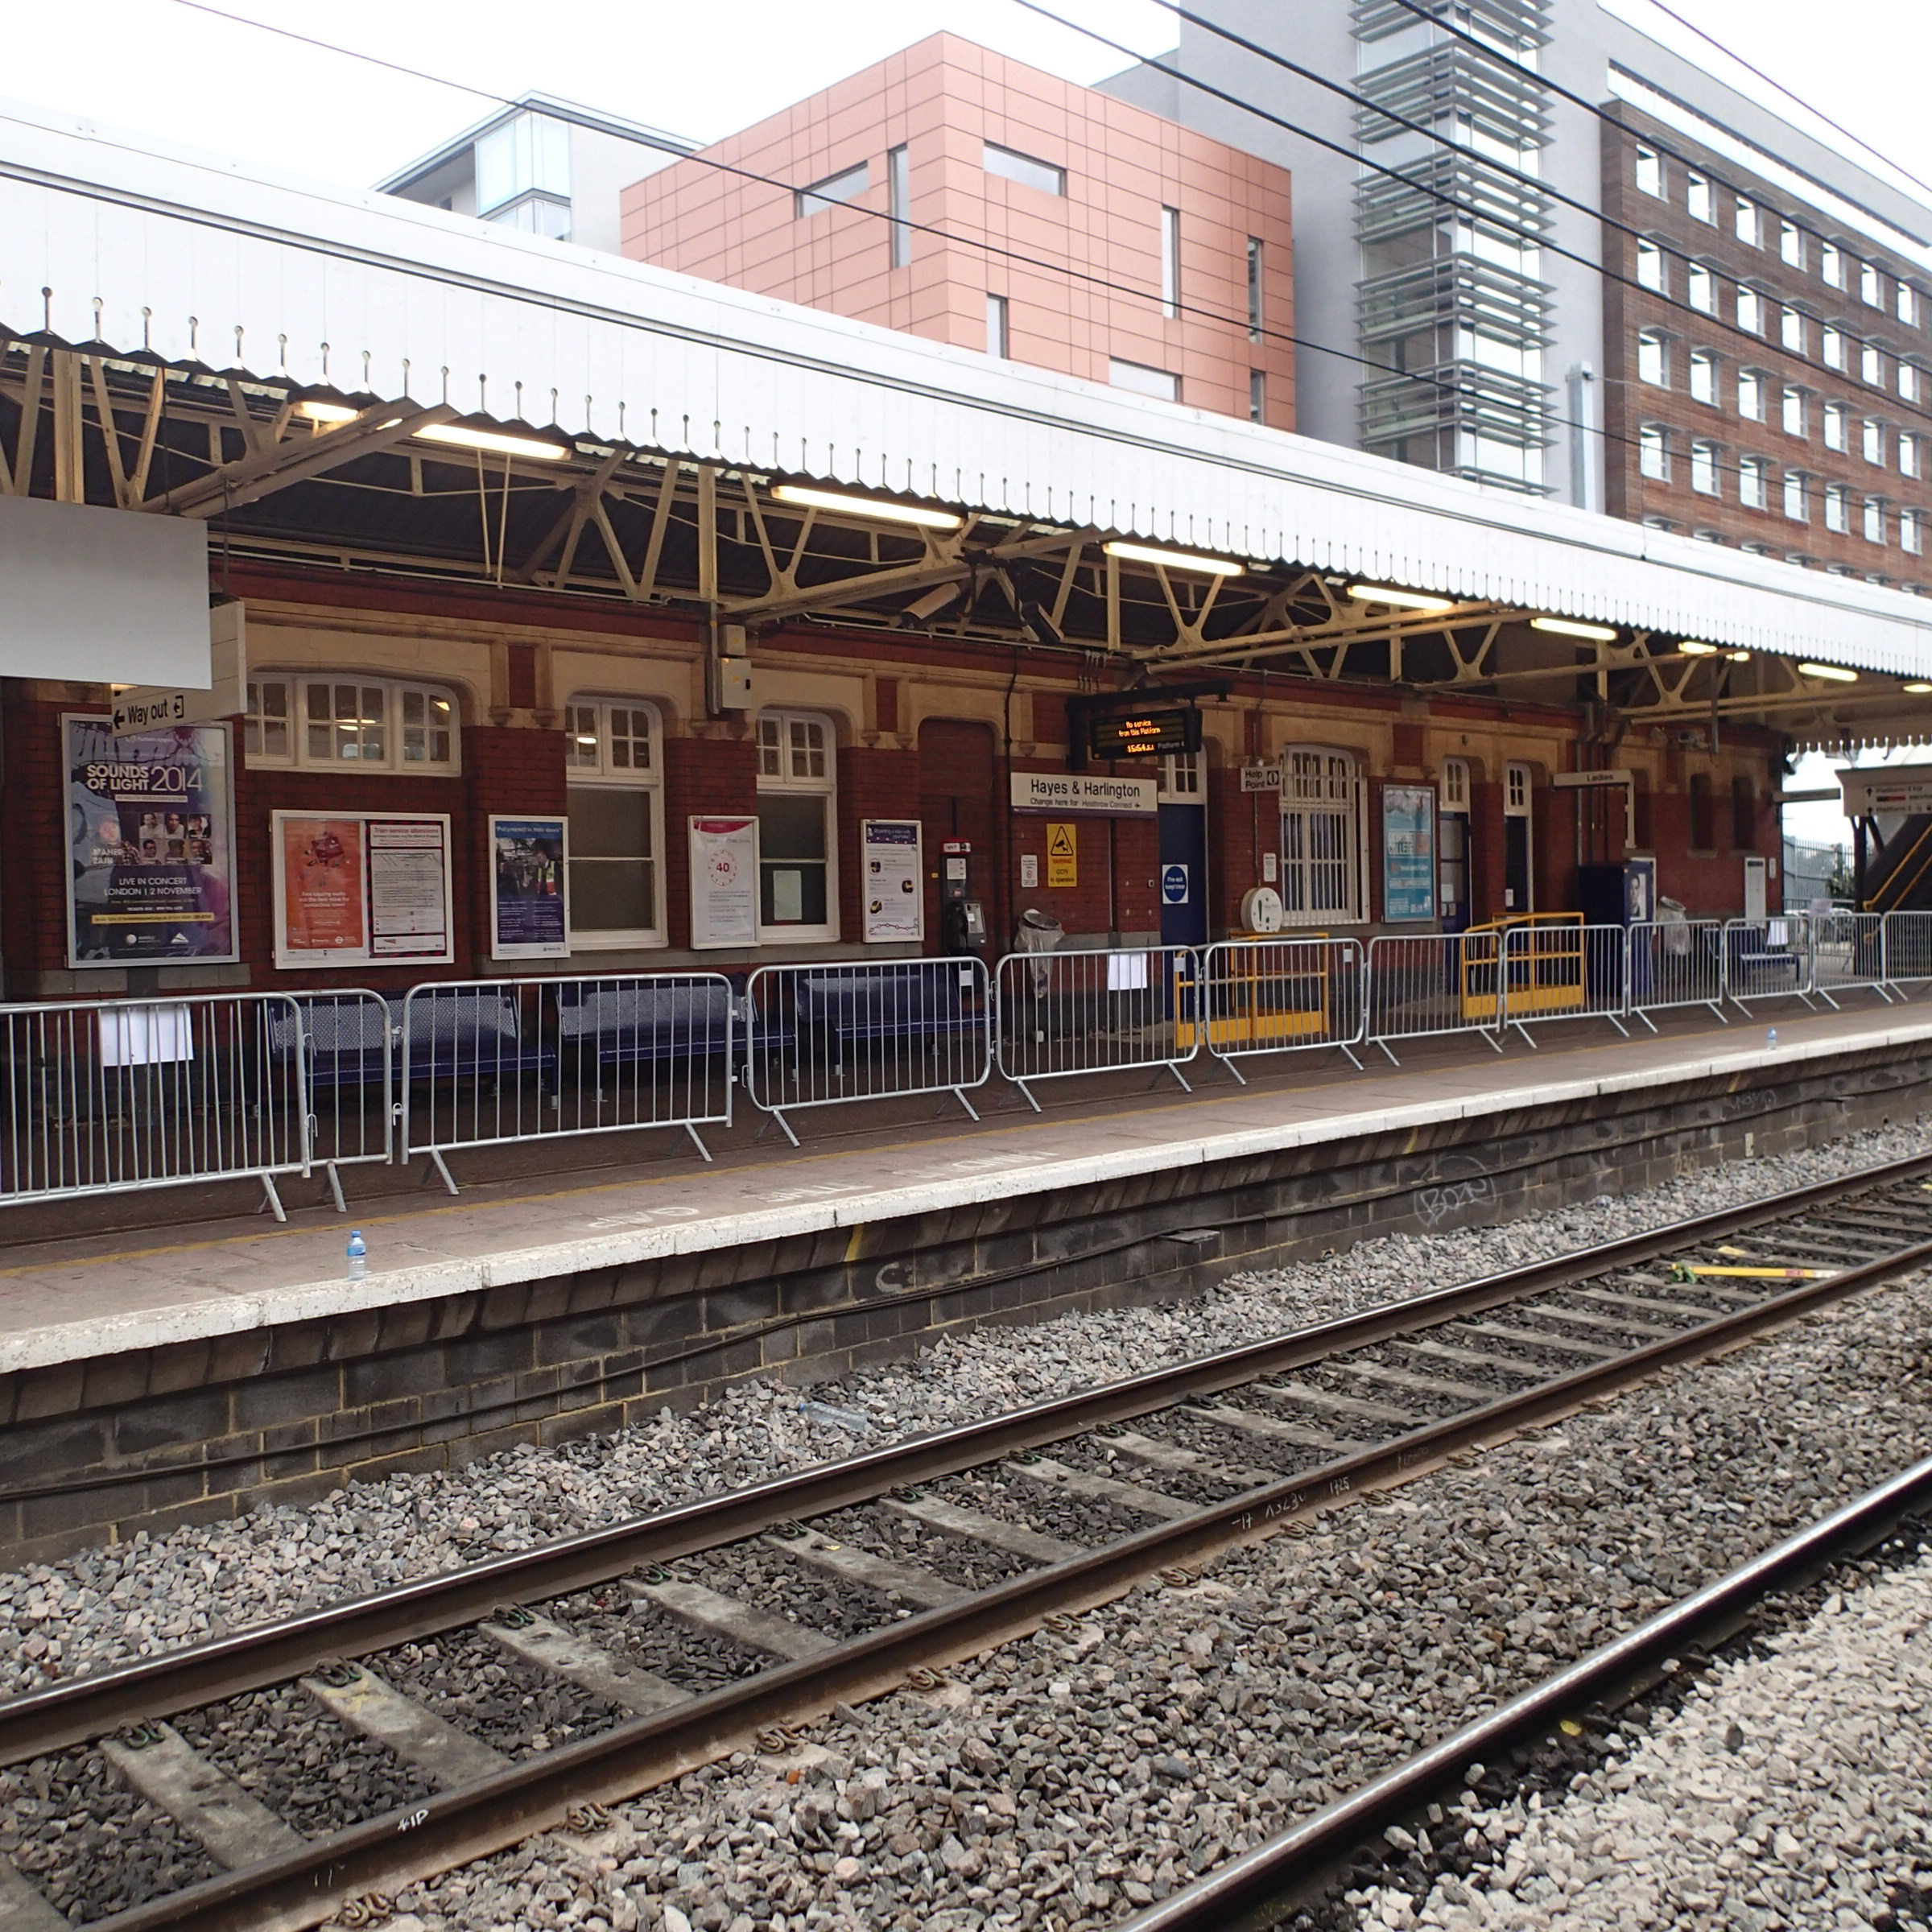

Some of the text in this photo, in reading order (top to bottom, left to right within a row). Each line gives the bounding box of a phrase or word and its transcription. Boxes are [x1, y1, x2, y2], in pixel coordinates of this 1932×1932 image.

[128, 699, 168, 724] Way out
[1134, 720, 1152, 728] service
[86, 765, 203, 792] SOUNDS 2014
[1245, 770, 1263, 779] Help
[87, 778, 150, 791] OF LIGHT
[1031, 779, 1140, 799] Hayes & Harlington
[1245, 781, 1265, 789] Point
[1030, 798, 1054, 807] Change
[1110, 801, 1133, 809] Connect
[716, 862, 729, 873] 40
[119, 877, 188, 886] LIVE IN CONCERT
[104, 886, 142, 896] LONDON
[151, 887, 156, 895] 2
[157, 886, 202, 895] NOVEMBER
[588, 1207, 701, 1229] GAP
